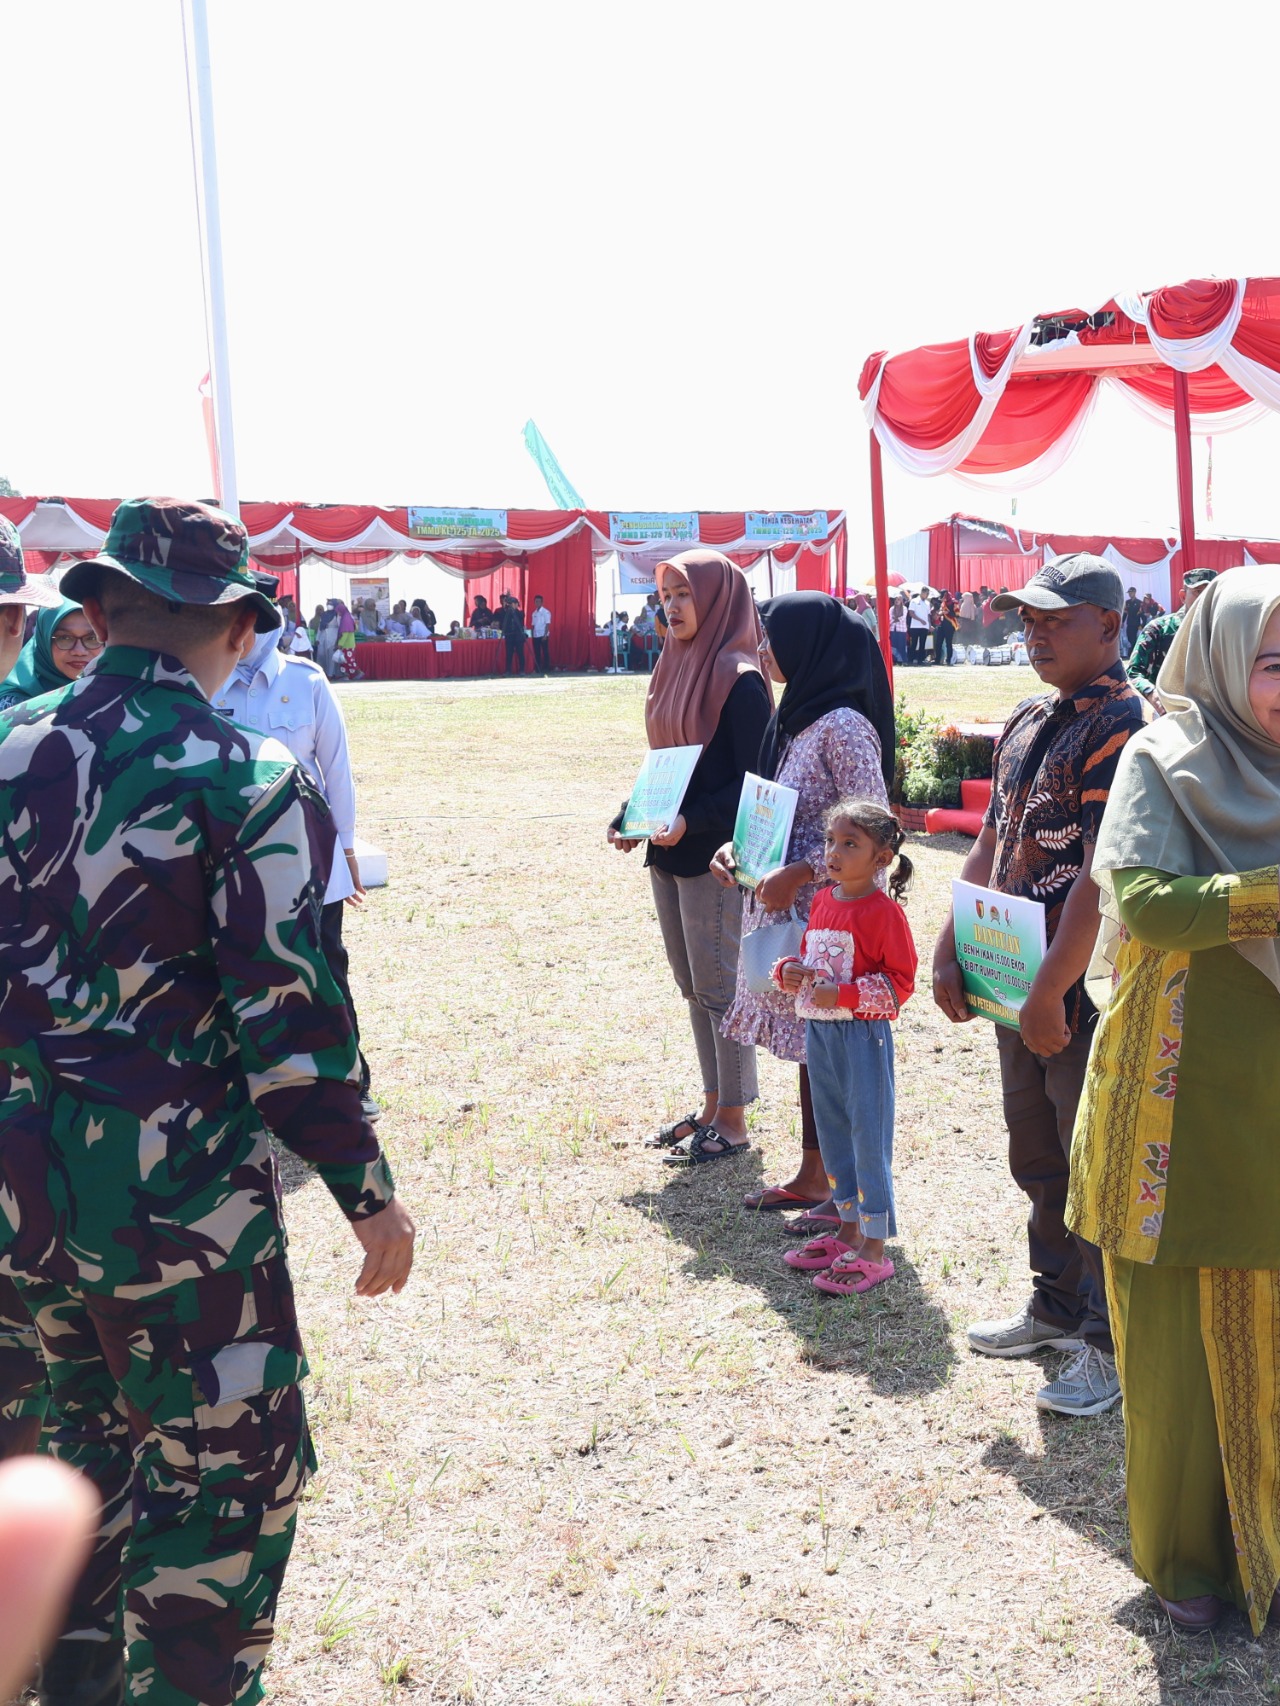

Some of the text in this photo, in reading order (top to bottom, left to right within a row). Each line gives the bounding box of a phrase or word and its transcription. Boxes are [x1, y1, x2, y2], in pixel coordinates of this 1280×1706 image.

[416, 526, 440, 535] TMMD
[480, 527, 500, 537] 2025
[973, 923, 1021, 955] BANTUAN
[963, 943, 980, 957] BENIH
[980, 949, 994, 962] IKAN
